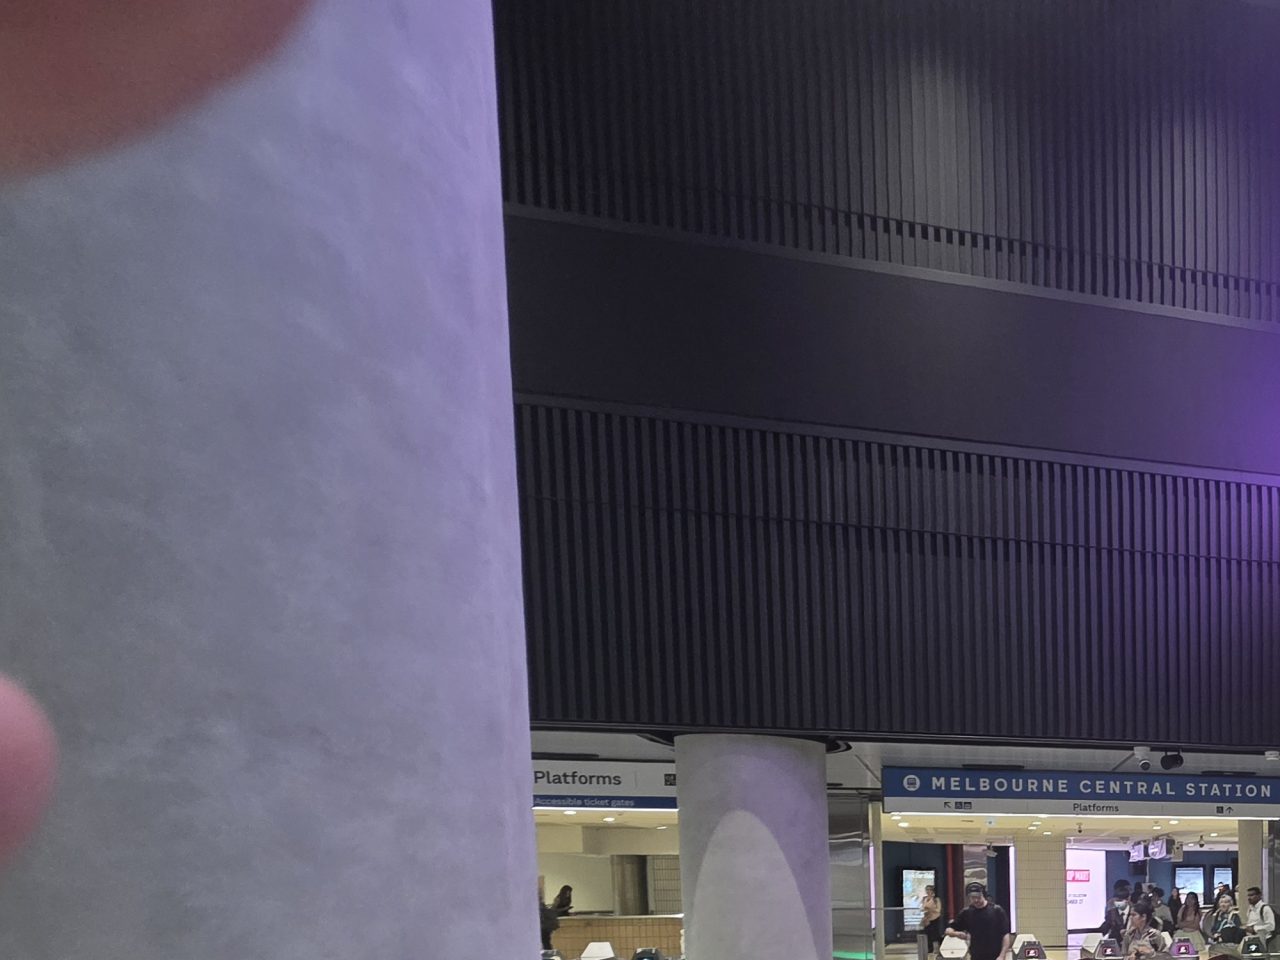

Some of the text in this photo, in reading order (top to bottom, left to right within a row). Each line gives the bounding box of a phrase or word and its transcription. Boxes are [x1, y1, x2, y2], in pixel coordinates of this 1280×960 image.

[533, 770, 622, 786] Platforms
[931, 776, 1272, 798] MELBOURNE CENTRAL STATION
[534, 797, 635, 808] Accessible ticket gates
[1072, 802, 1120, 814] Platforms
